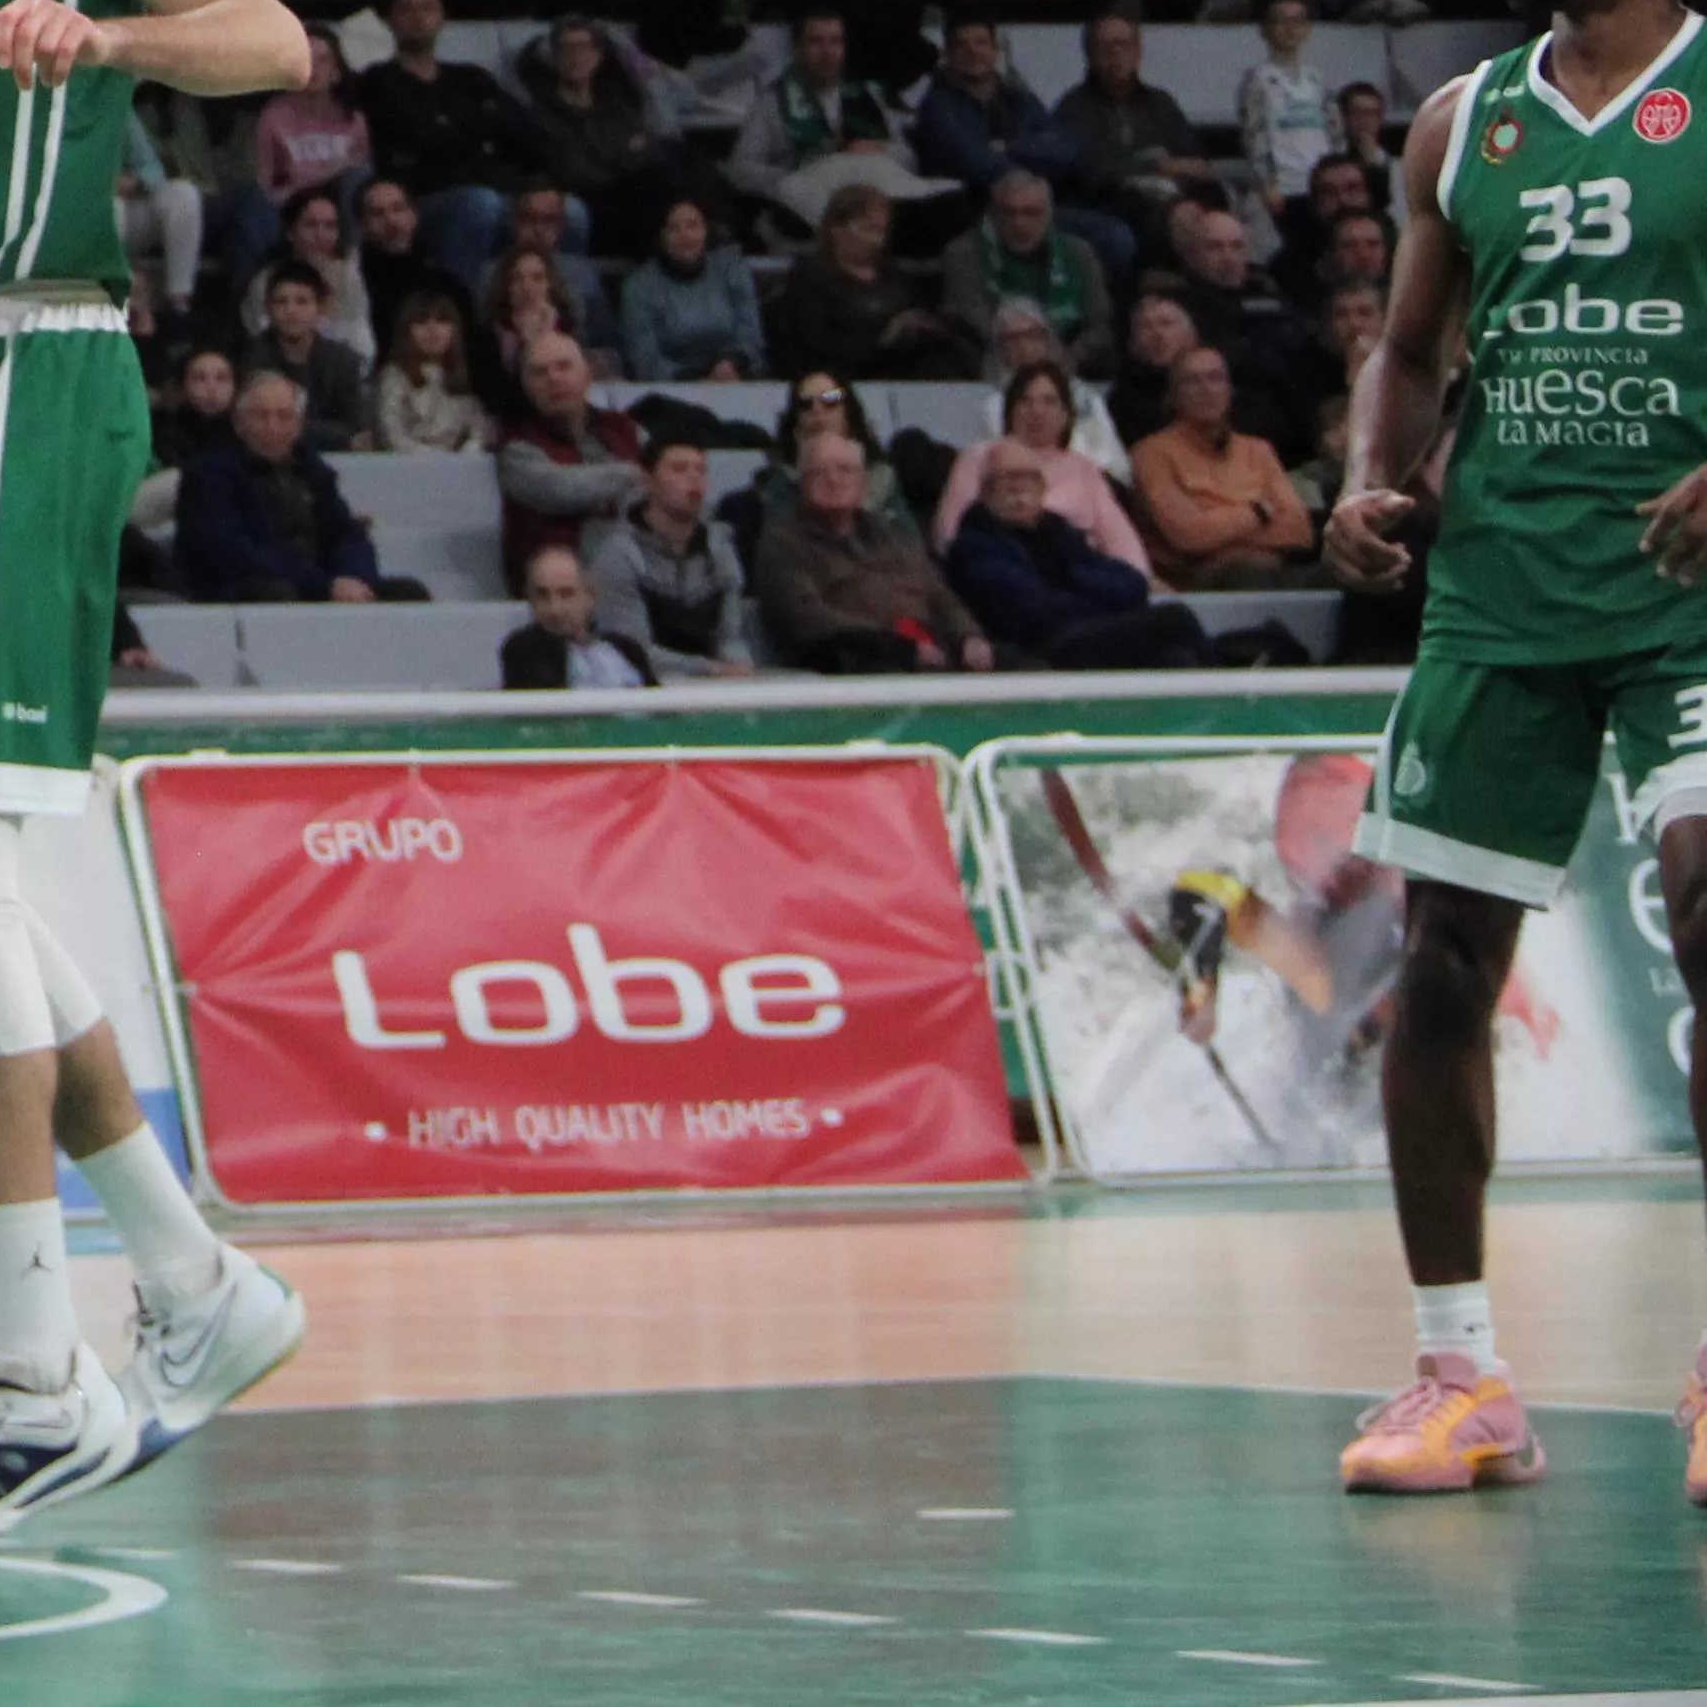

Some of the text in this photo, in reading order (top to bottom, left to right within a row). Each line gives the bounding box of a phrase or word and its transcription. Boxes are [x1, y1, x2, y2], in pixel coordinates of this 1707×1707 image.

[1519, 177, 1632, 262] 33
[302, 817, 464, 865] GRUPO
[331, 922, 846, 1051] Lobe
[407, 1097, 811, 1155] HIGH QUALITY HOMES
